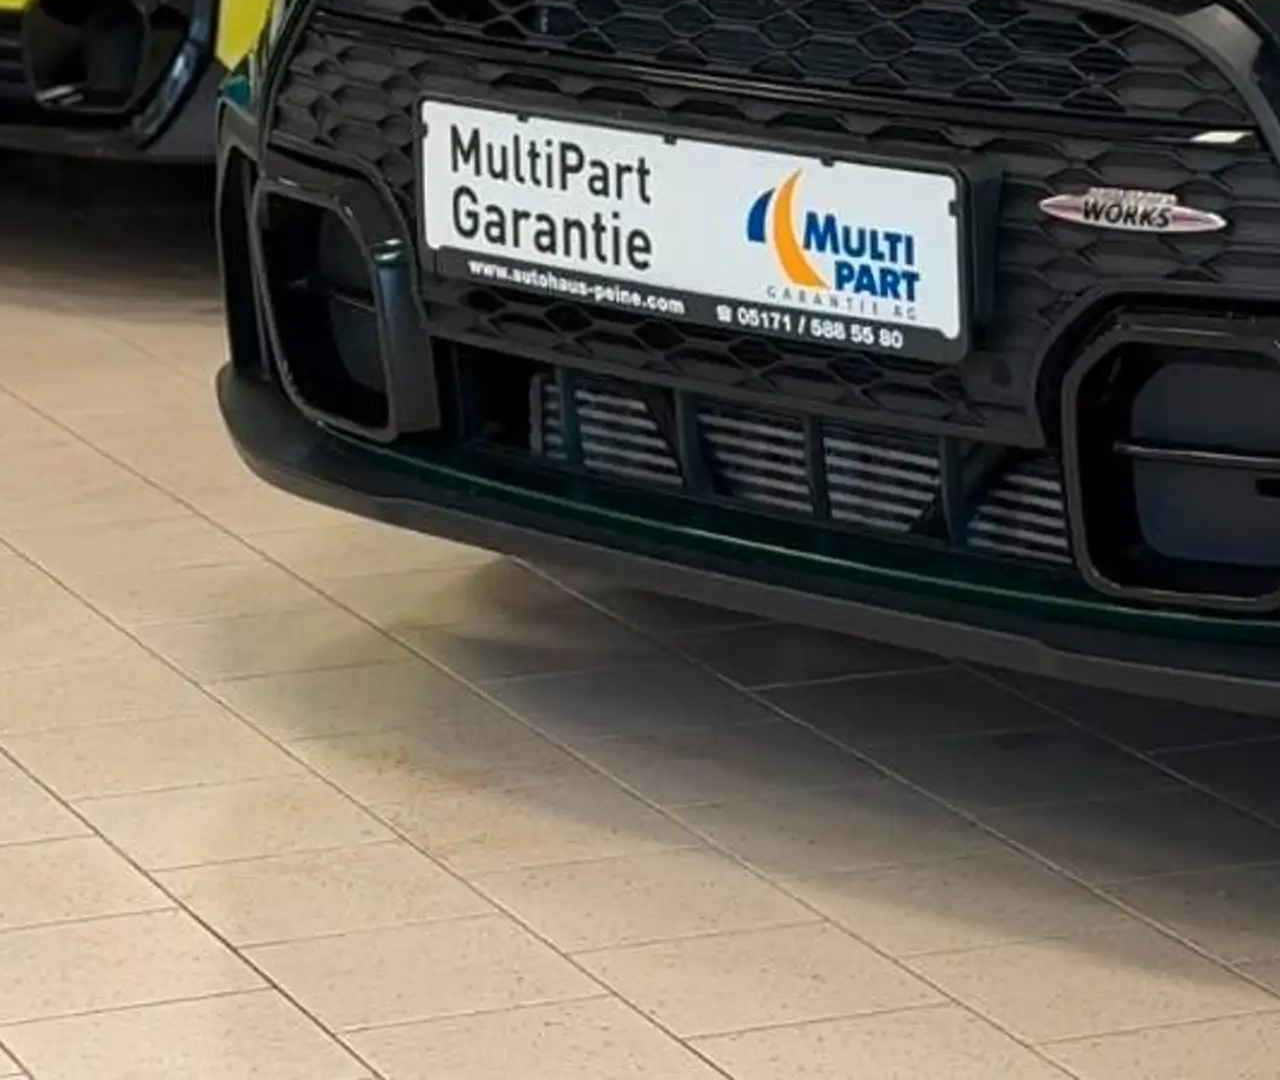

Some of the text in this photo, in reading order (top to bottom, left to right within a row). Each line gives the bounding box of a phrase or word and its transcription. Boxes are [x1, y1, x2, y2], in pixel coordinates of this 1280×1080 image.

[450, 123, 652, 205] MultiPart
[452, 185, 652, 271] Garantie
[1083, 199, 1170, 228] WORKS
[467, 259, 685, 315] www.autohaus-peine.com
[834, 259, 920, 302] PART
[737, 306, 790, 333] 05171
[810, 318, 846, 340] 588
[850, 323, 874, 344] 55
[879, 328, 904, 350] 80
